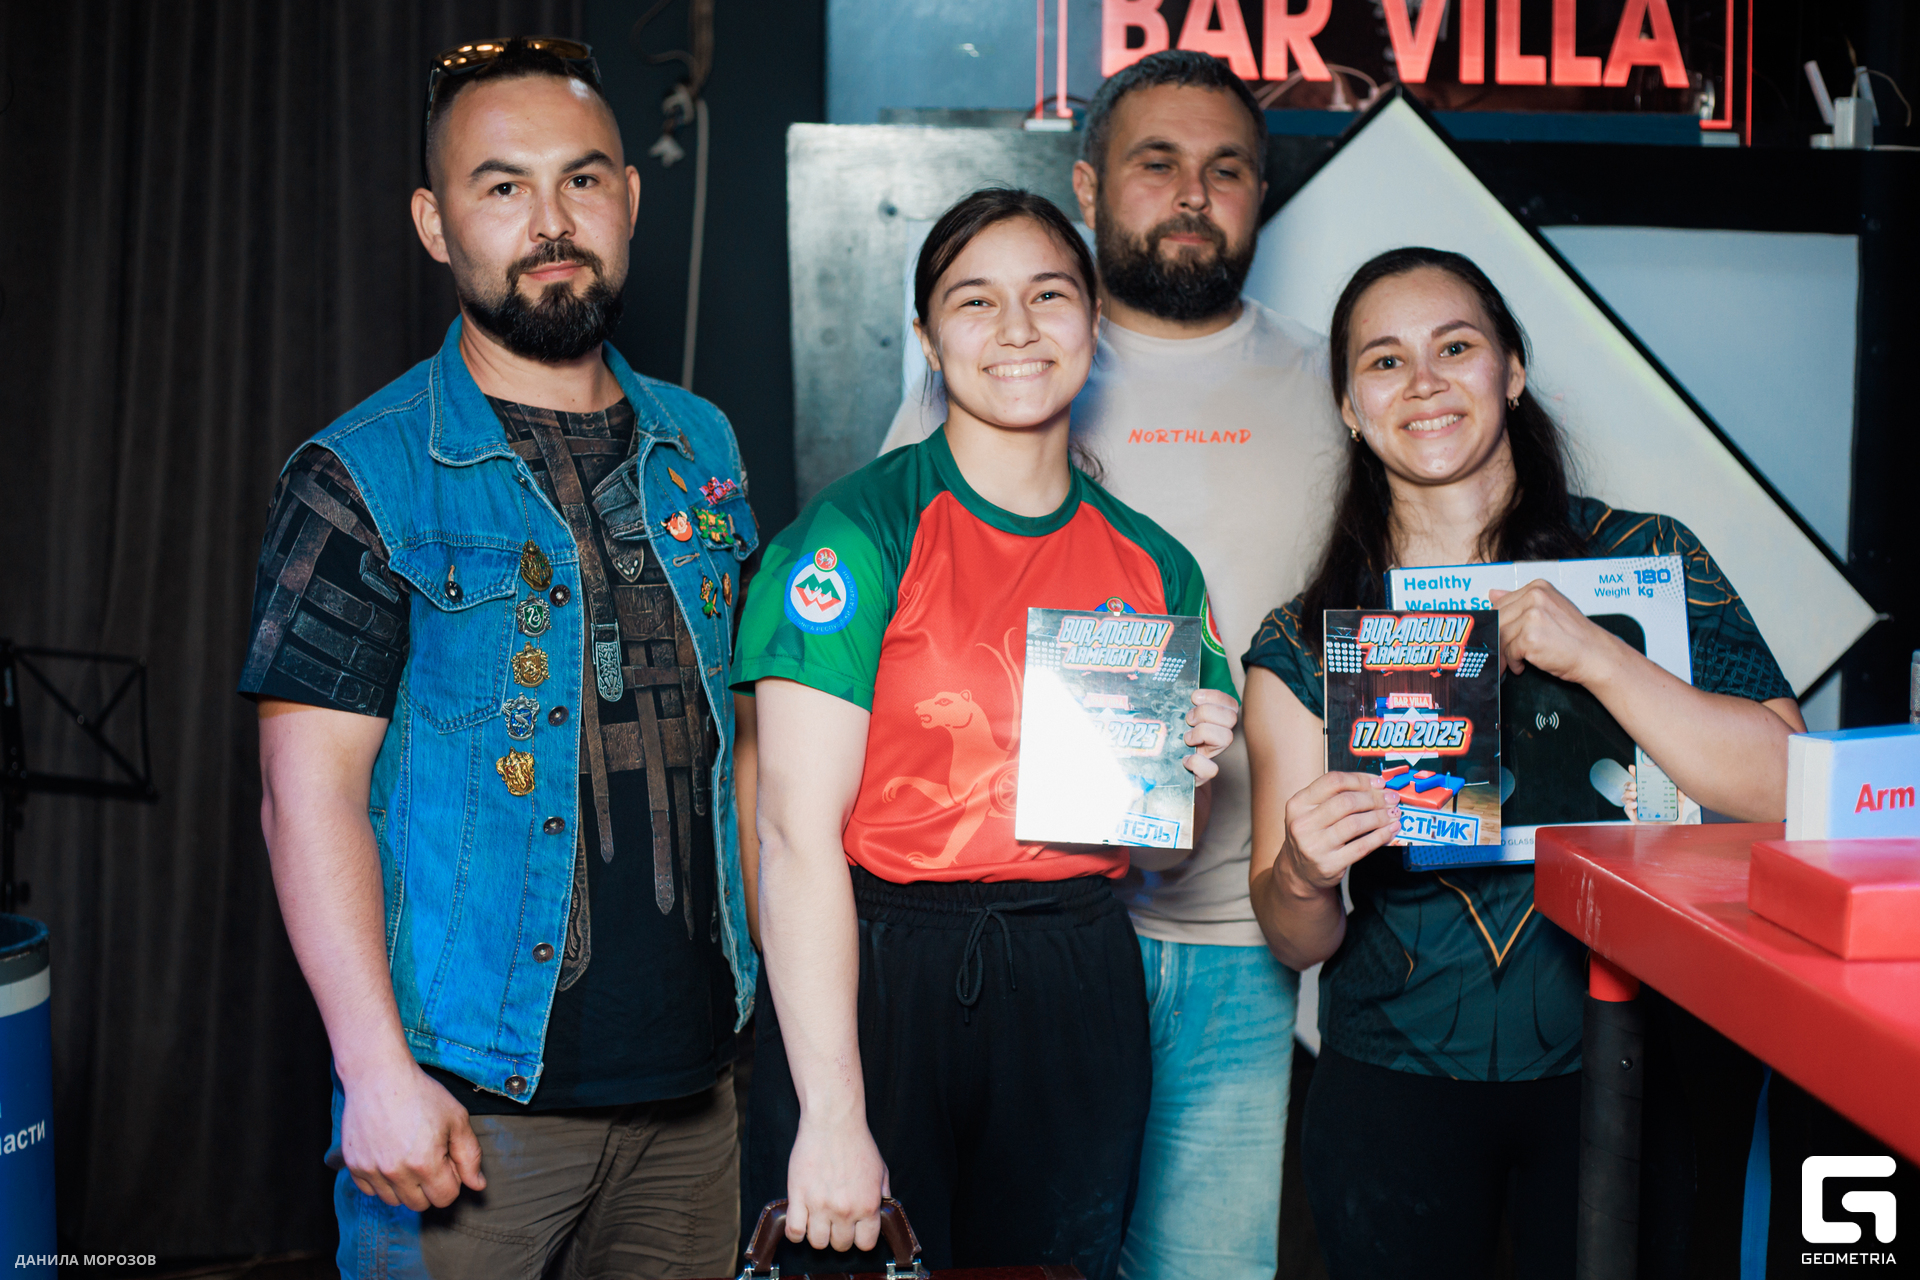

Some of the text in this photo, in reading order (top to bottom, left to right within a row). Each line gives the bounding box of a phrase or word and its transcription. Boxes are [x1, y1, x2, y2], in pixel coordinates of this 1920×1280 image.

[1101, 0, 1689, 88] BAR VILLA
[1127, 429, 1252, 444] NORTHLAND
[1404, 575, 1471, 591] Healthy
[1599, 568, 1671, 584] MAX 180
[1594, 586, 1653, 598] Weight Kg
[1405, 597, 1494, 610] Weight Sc
[1060, 618, 1169, 648] BURANGULOV
[1359, 617, 1469, 646] BURANGULOV
[1064, 646, 1158, 667] ARMFIGHT #3
[1366, 645, 1460, 665] ARMFIGHT #3
[1394, 696, 1428, 706] BAR VILLA
[1352, 721, 1466, 748] 17.08.2025
[1854, 783, 1915, 814] Arm
[1115, 819, 1171, 843] ТЕЛЬ
[1399, 815, 1470, 840] СТНИК
[1508, 838, 1534, 846] GLASS
